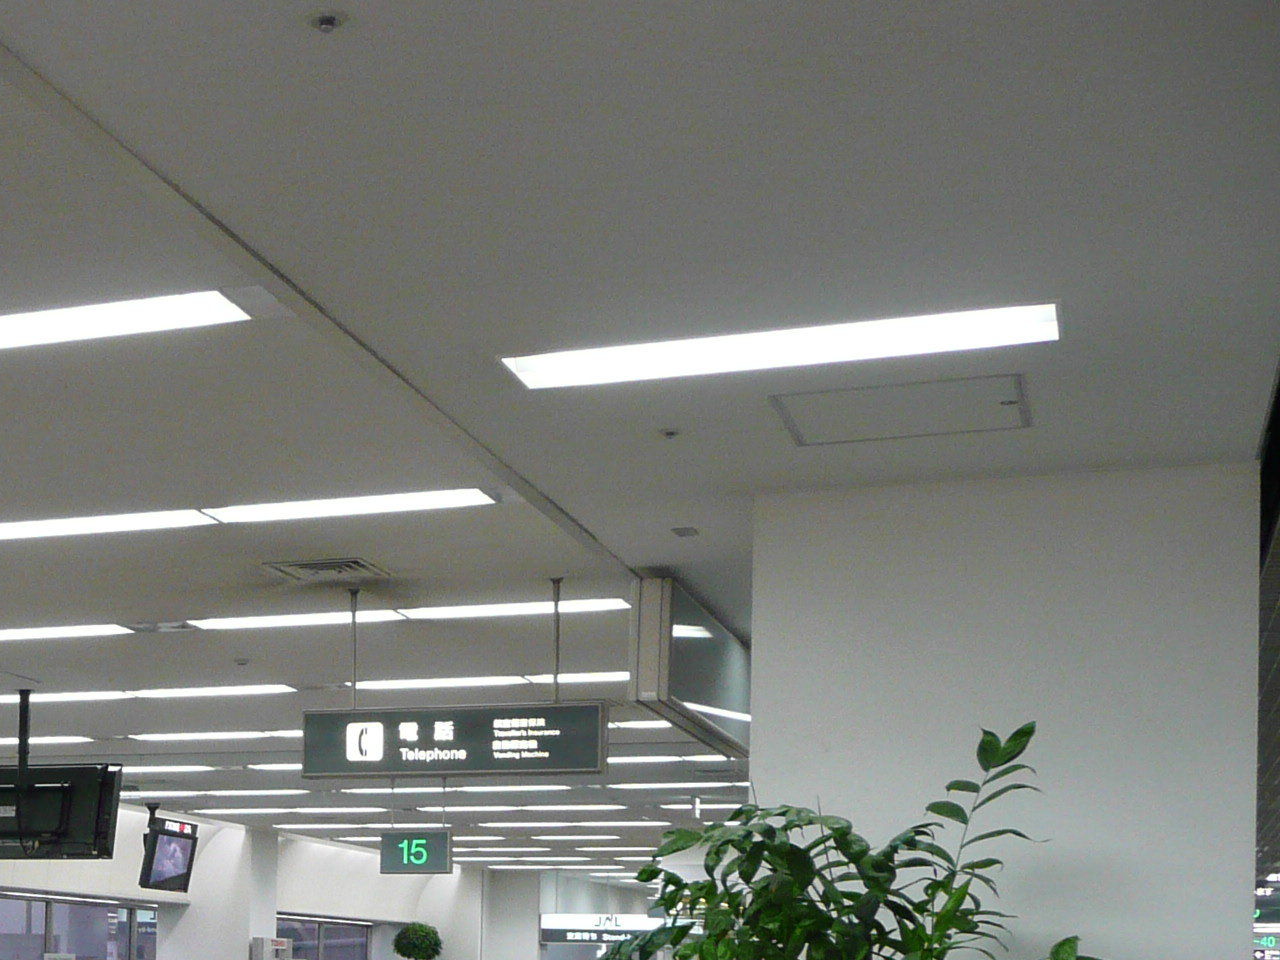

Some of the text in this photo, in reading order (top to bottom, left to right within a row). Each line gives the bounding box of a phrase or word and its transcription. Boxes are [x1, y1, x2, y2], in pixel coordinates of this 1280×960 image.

[399, 747, 467, 762] Telephone
[398, 839, 428, 864] 15
[594, 914, 621, 928] JAL
